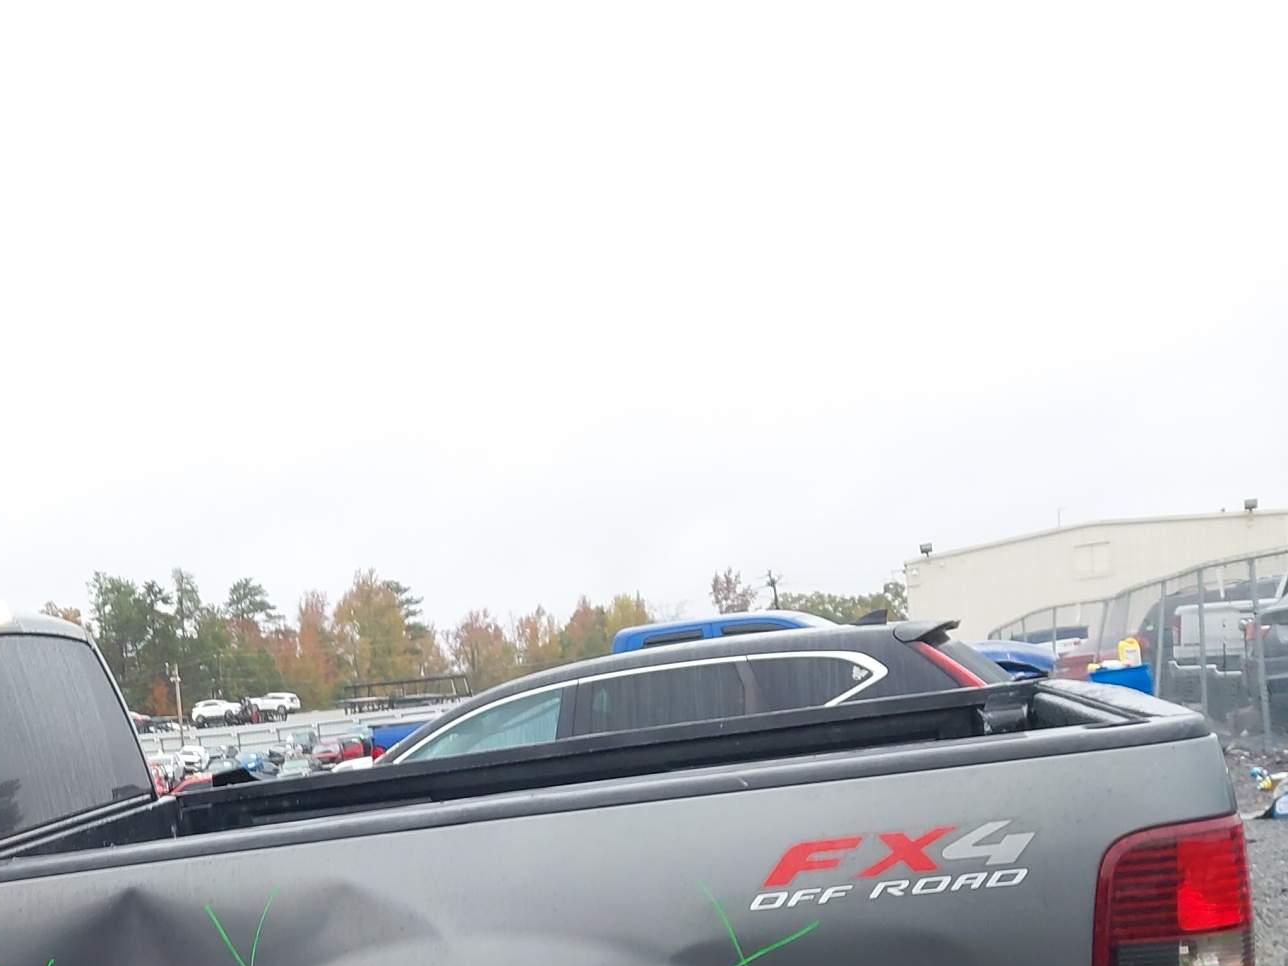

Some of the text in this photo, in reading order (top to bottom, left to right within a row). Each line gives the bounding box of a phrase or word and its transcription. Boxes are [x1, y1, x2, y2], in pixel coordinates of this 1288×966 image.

[762, 820, 1035, 888] FX4
[750, 868, 1029, 911] OFF ROAD
